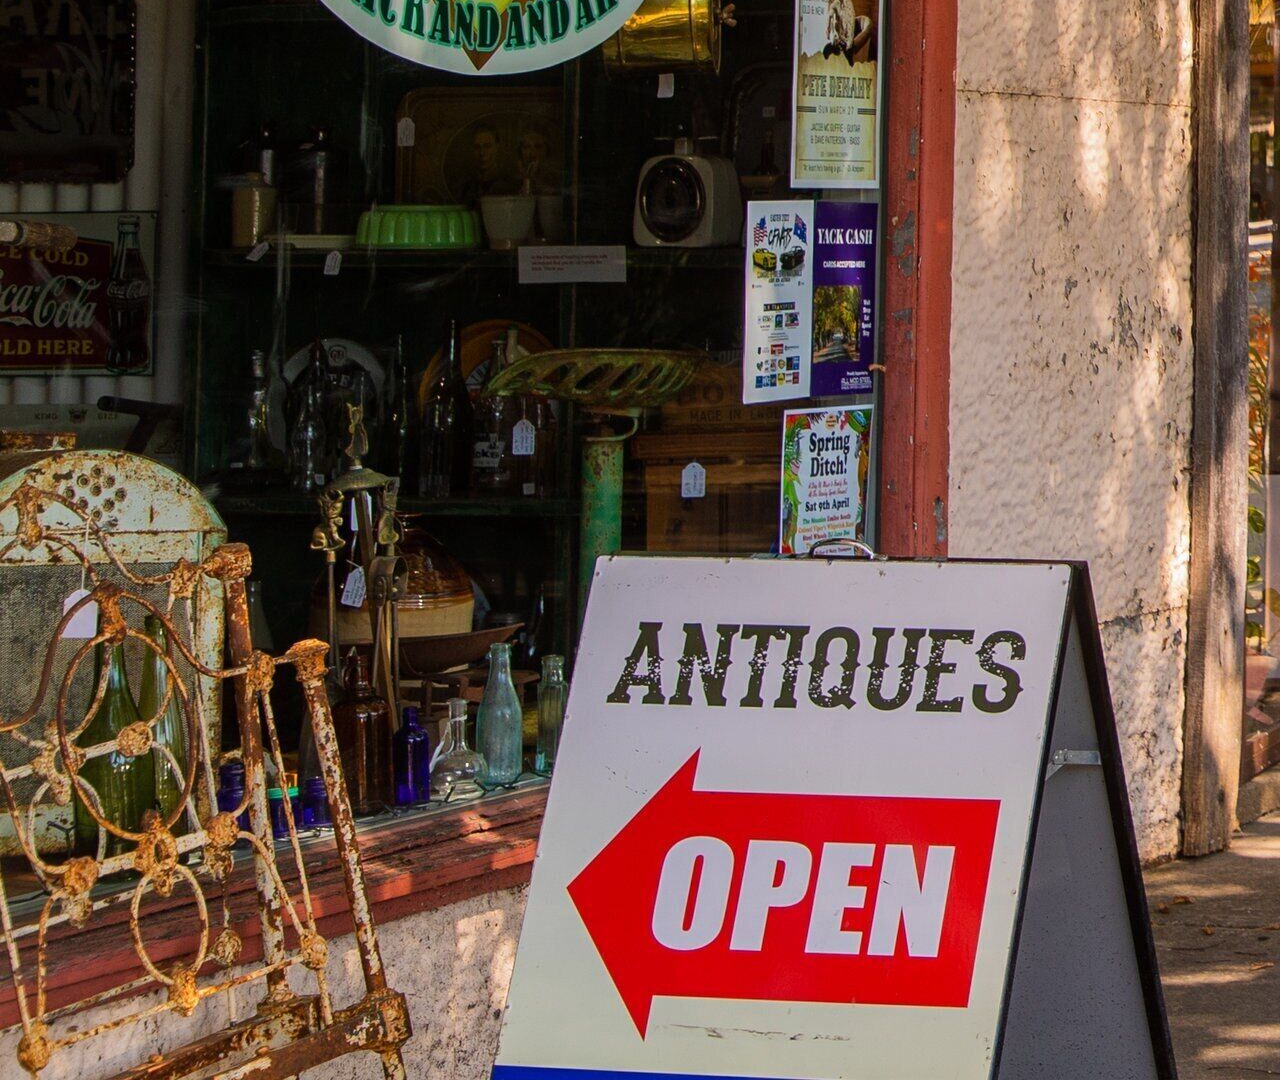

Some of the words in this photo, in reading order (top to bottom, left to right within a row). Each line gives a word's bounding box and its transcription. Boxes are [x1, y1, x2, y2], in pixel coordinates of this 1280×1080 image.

[801, 74, 827, 97] PETE
[817, 228, 844, 245] YACK
[845, 228, 873, 245] CASH
[0, 340, 31, 355] LD
[37, 339, 95, 356] HERE
[809, 431, 850, 457] Spring
[810, 453, 848, 477] Ditch!
[805, 501, 817, 512] Sat
[818, 499, 830, 512] 9th
[831, 497, 850, 511] April
[606, 620, 1027, 714] ANTIQUES
[651, 834, 955, 959] OPEN
